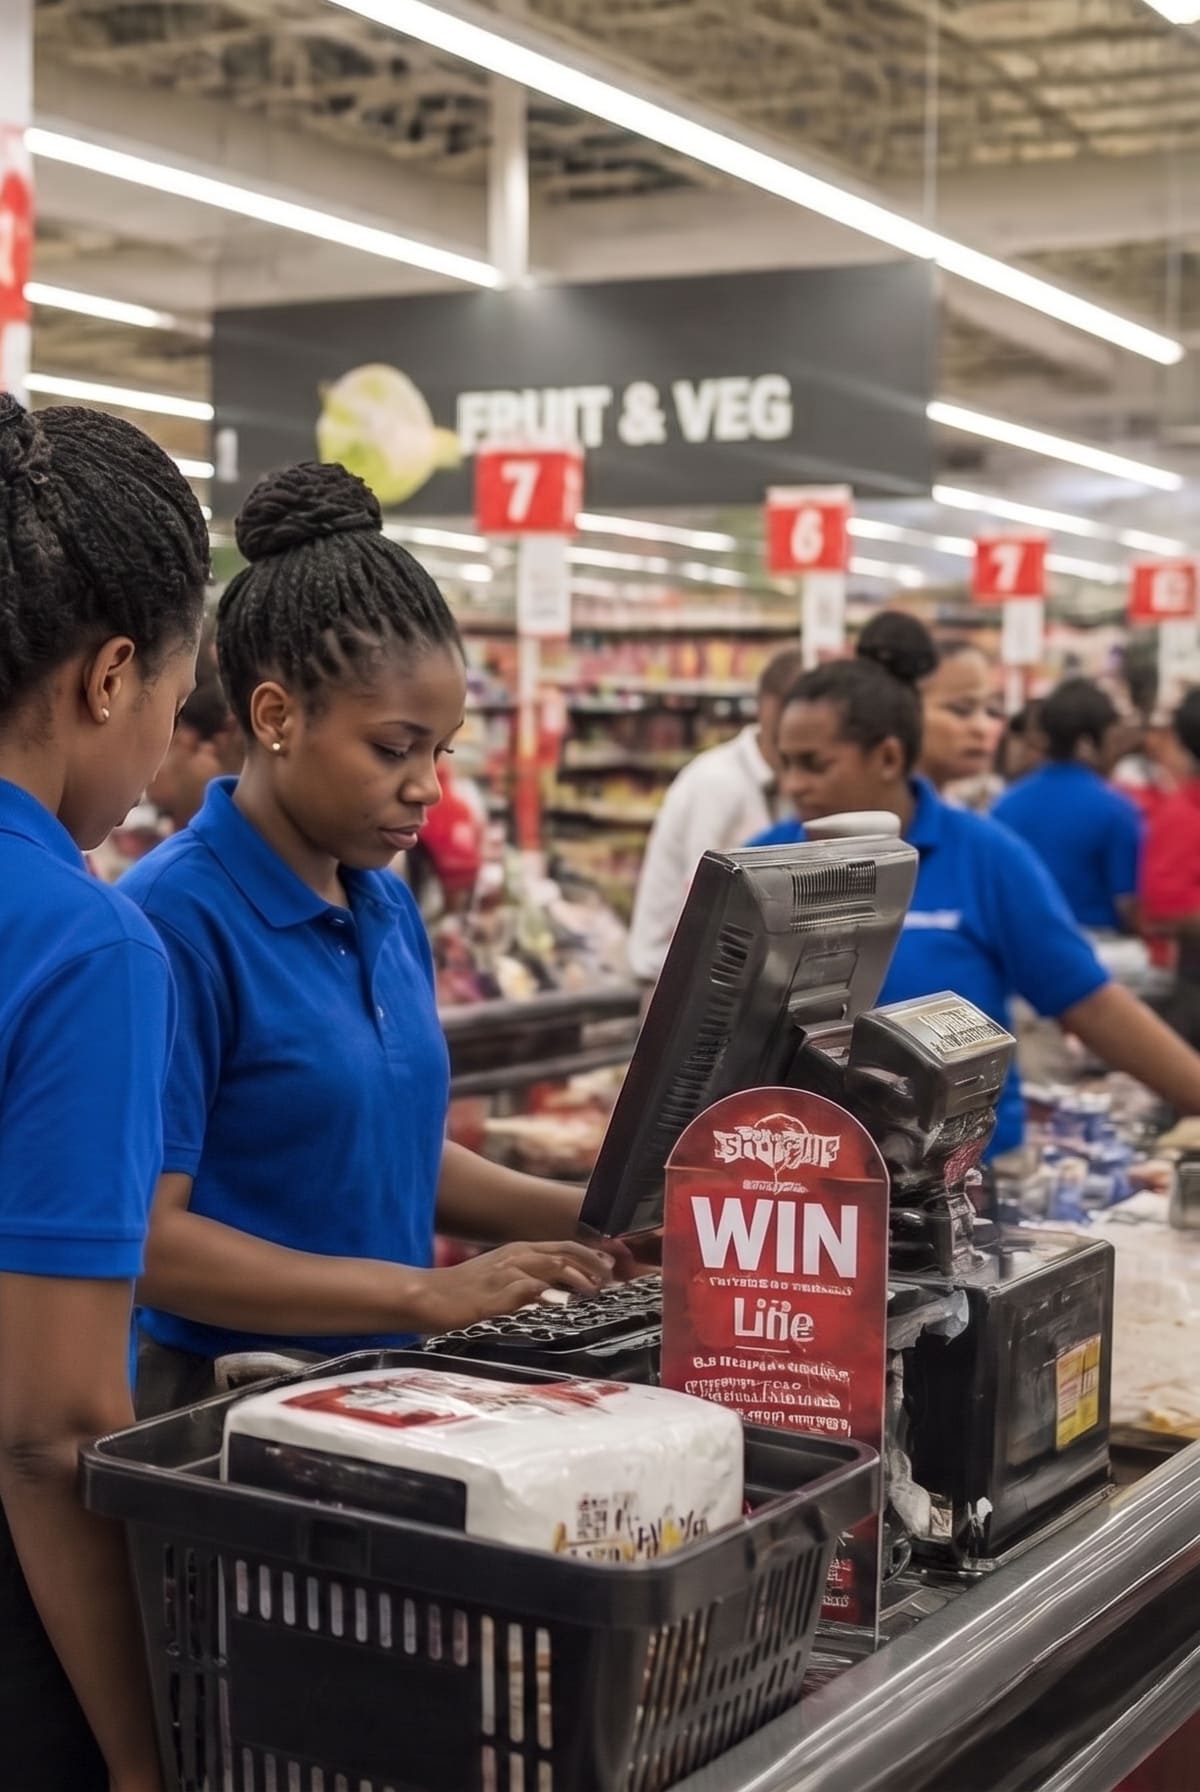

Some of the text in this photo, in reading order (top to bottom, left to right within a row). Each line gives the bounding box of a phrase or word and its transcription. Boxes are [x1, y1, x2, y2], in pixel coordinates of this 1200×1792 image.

[456, 373, 794, 455] FRUIT & VEG
[501, 459, 540, 524] 7
[790, 508, 824, 565] 6
[990, 543, 1024, 592] 7
[690, 1195, 859, 1279] WIN
